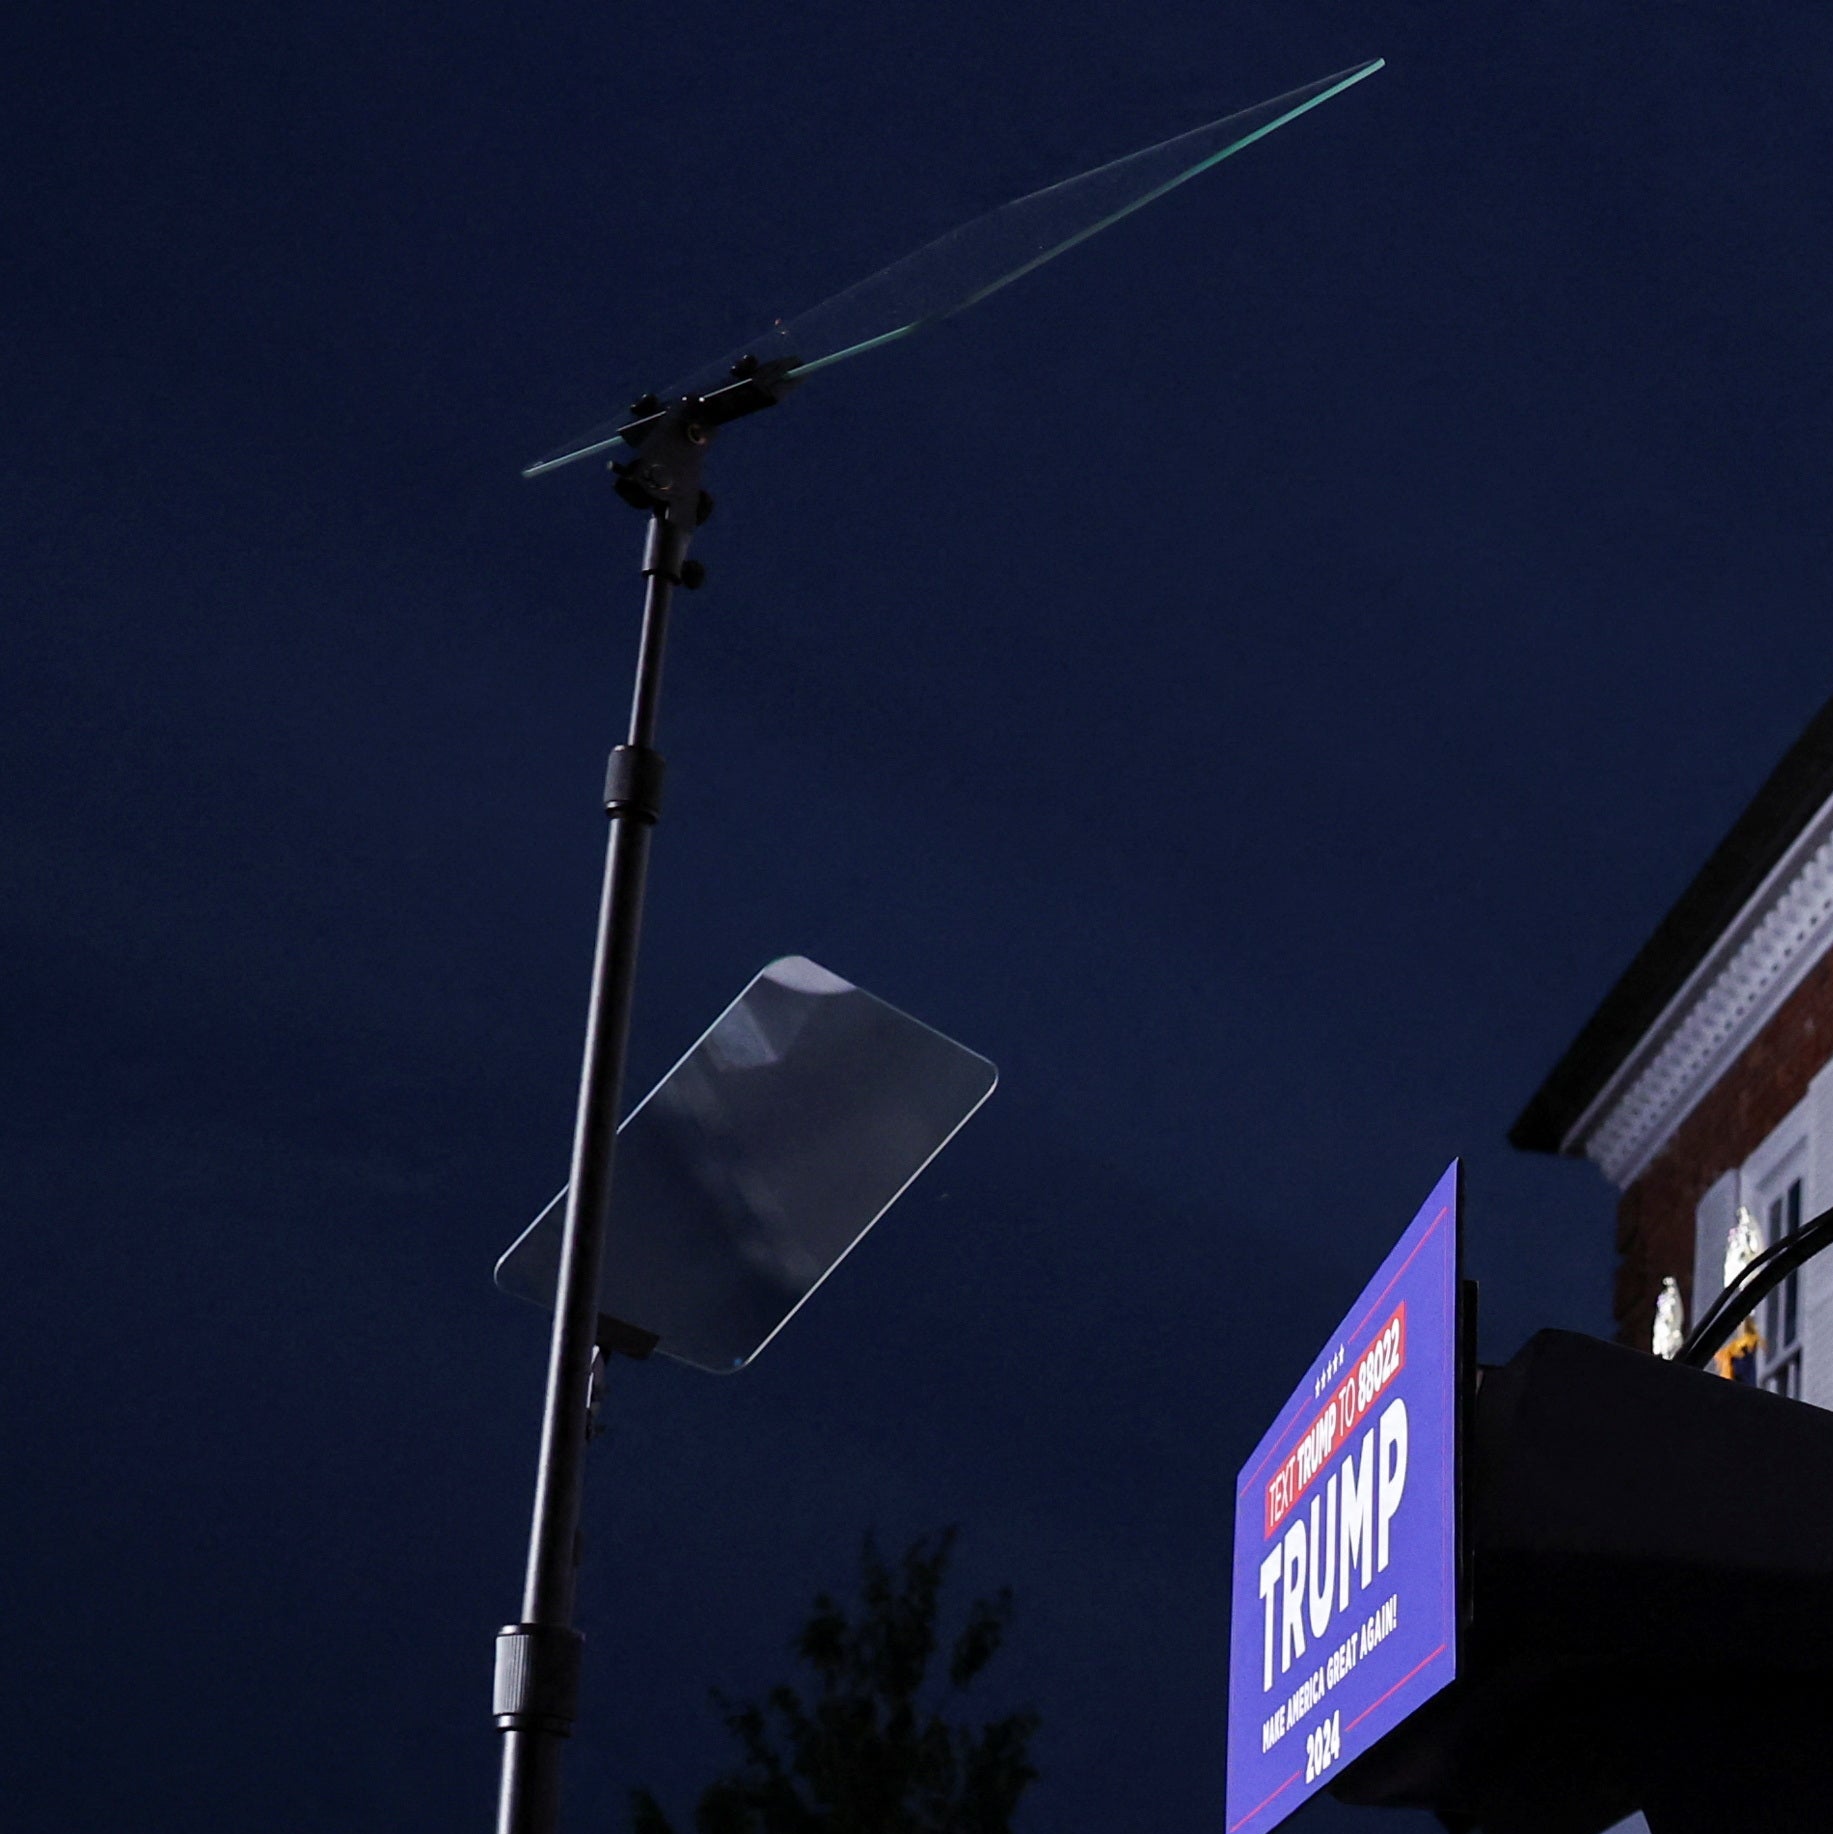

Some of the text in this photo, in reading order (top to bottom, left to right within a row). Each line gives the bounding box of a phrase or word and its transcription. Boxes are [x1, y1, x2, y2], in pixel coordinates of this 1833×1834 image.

[1268, 1317, 1400, 1527] TEXT TRUMP TO 88022
[1259, 1397, 1408, 1692] TRUMP
[1262, 1593, 1398, 1754] MAKE AMERICA GREAT AGAIN!
[1305, 1709, 1341, 1784] 2024
